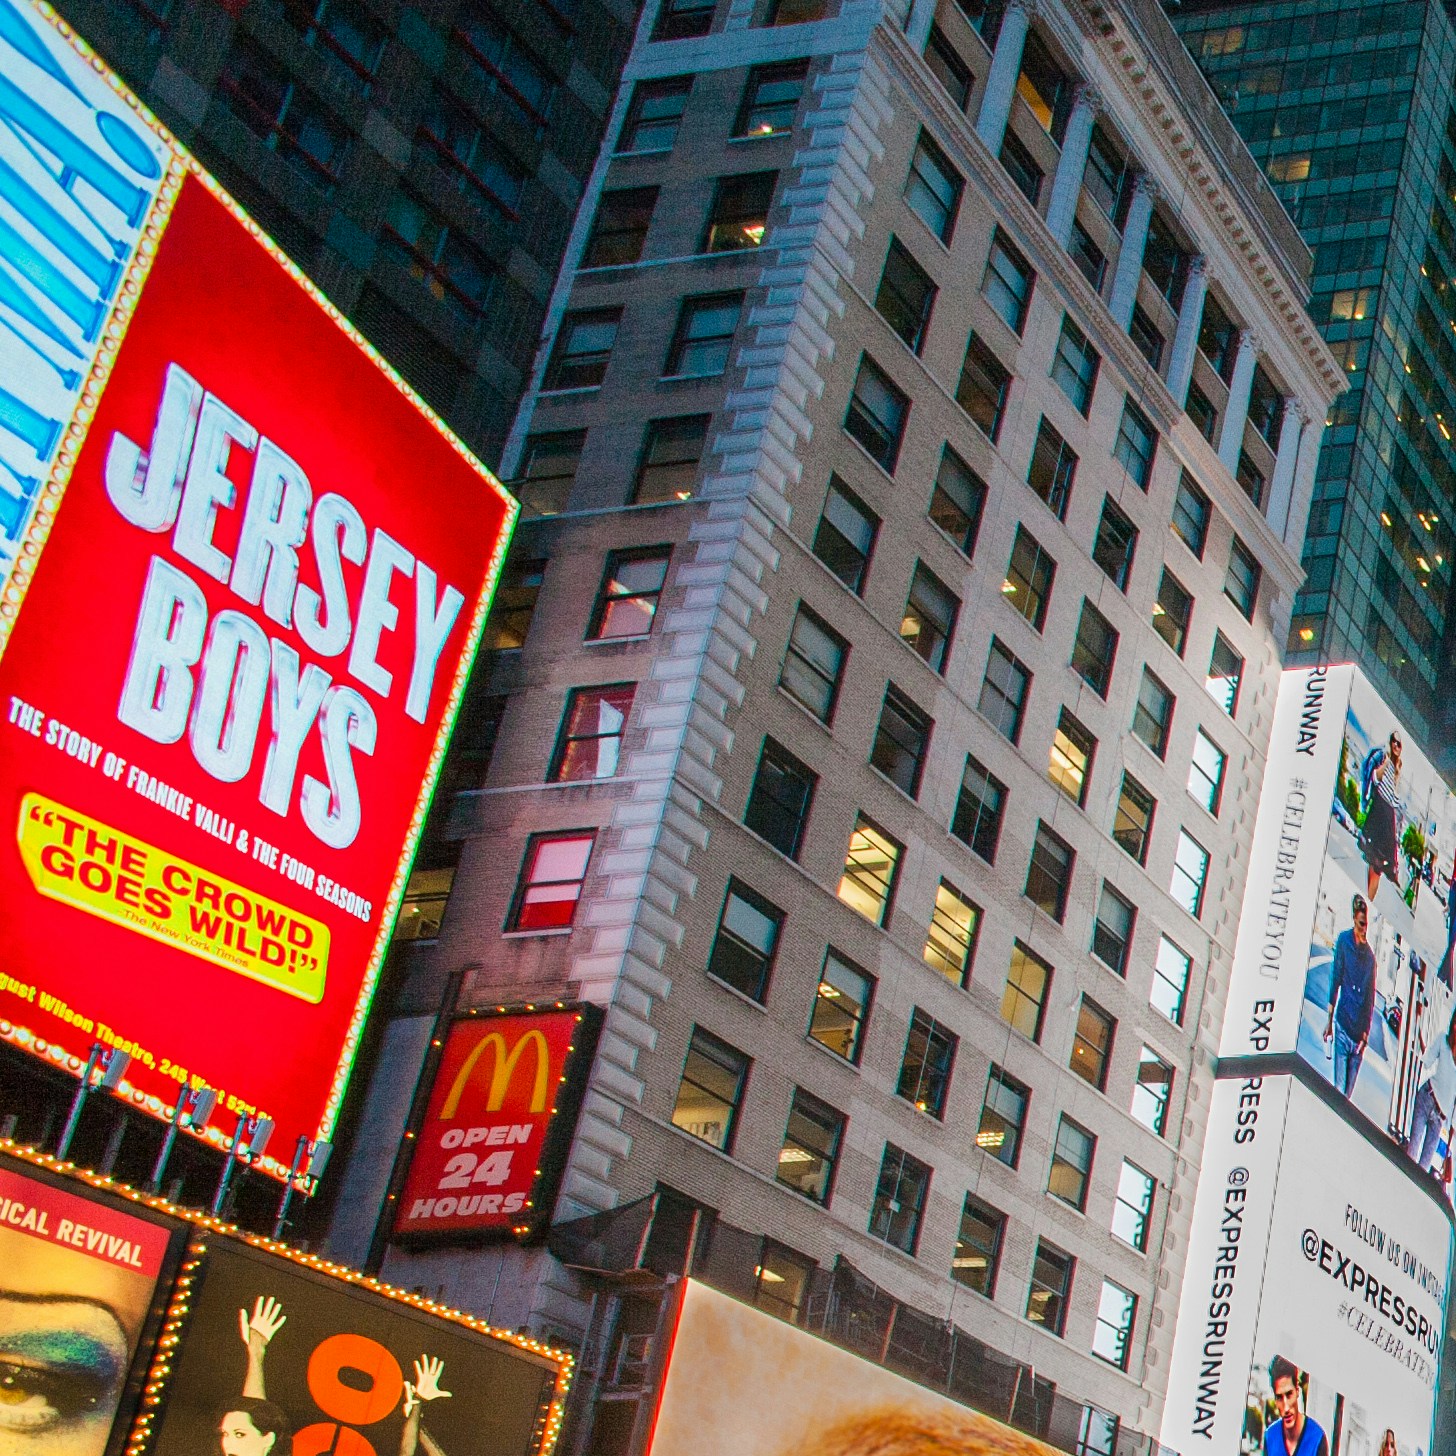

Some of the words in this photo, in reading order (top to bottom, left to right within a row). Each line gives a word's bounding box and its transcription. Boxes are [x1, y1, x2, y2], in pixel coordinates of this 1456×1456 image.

[105, 361, 464, 723] JERSEY
[117, 555, 377, 849] BOYS
[1297, 666, 1328, 757] RUNWAY
[9, 696, 45, 737] THE
[46, 715, 102, 768] STORY
[103, 752, 127, 781] OF
[127, 765, 194, 821] FRANKIE
[195, 803, 235, 845] VALLI
[235, 829, 249, 853] &
[252, 836, 280, 871] THE
[280, 852, 314, 890] FOUR
[315, 874, 373, 923] SEASONS
[41, 845, 173, 921] GOES
[162, 864, 314, 949] CROWD
[1259, 777, 1308, 981] #CELEBRATEYOU
[150, 920, 181, 939] New
[184, 932, 210, 953] York
[215, 946, 249, 968] Times
[39, 990, 94, 1034] Wilson
[97, 1022, 156, 1070] Theatre,
[159, 1058, 189, 1084] 245
[437, 1150, 515, 1190] 24
[439, 1124, 532, 1150] OPEN
[56, 1216, 143, 1268] REVIVAL
[409, 1192, 525, 1219] HOURS
[1344, 1202, 1386, 1258] FOLLOW
[1387, 1236, 1402, 1266] US
[1403, 1249, 1417, 1279] ON
[1189, 1164, 1250, 1441] @EXPRESSRUNWAY
